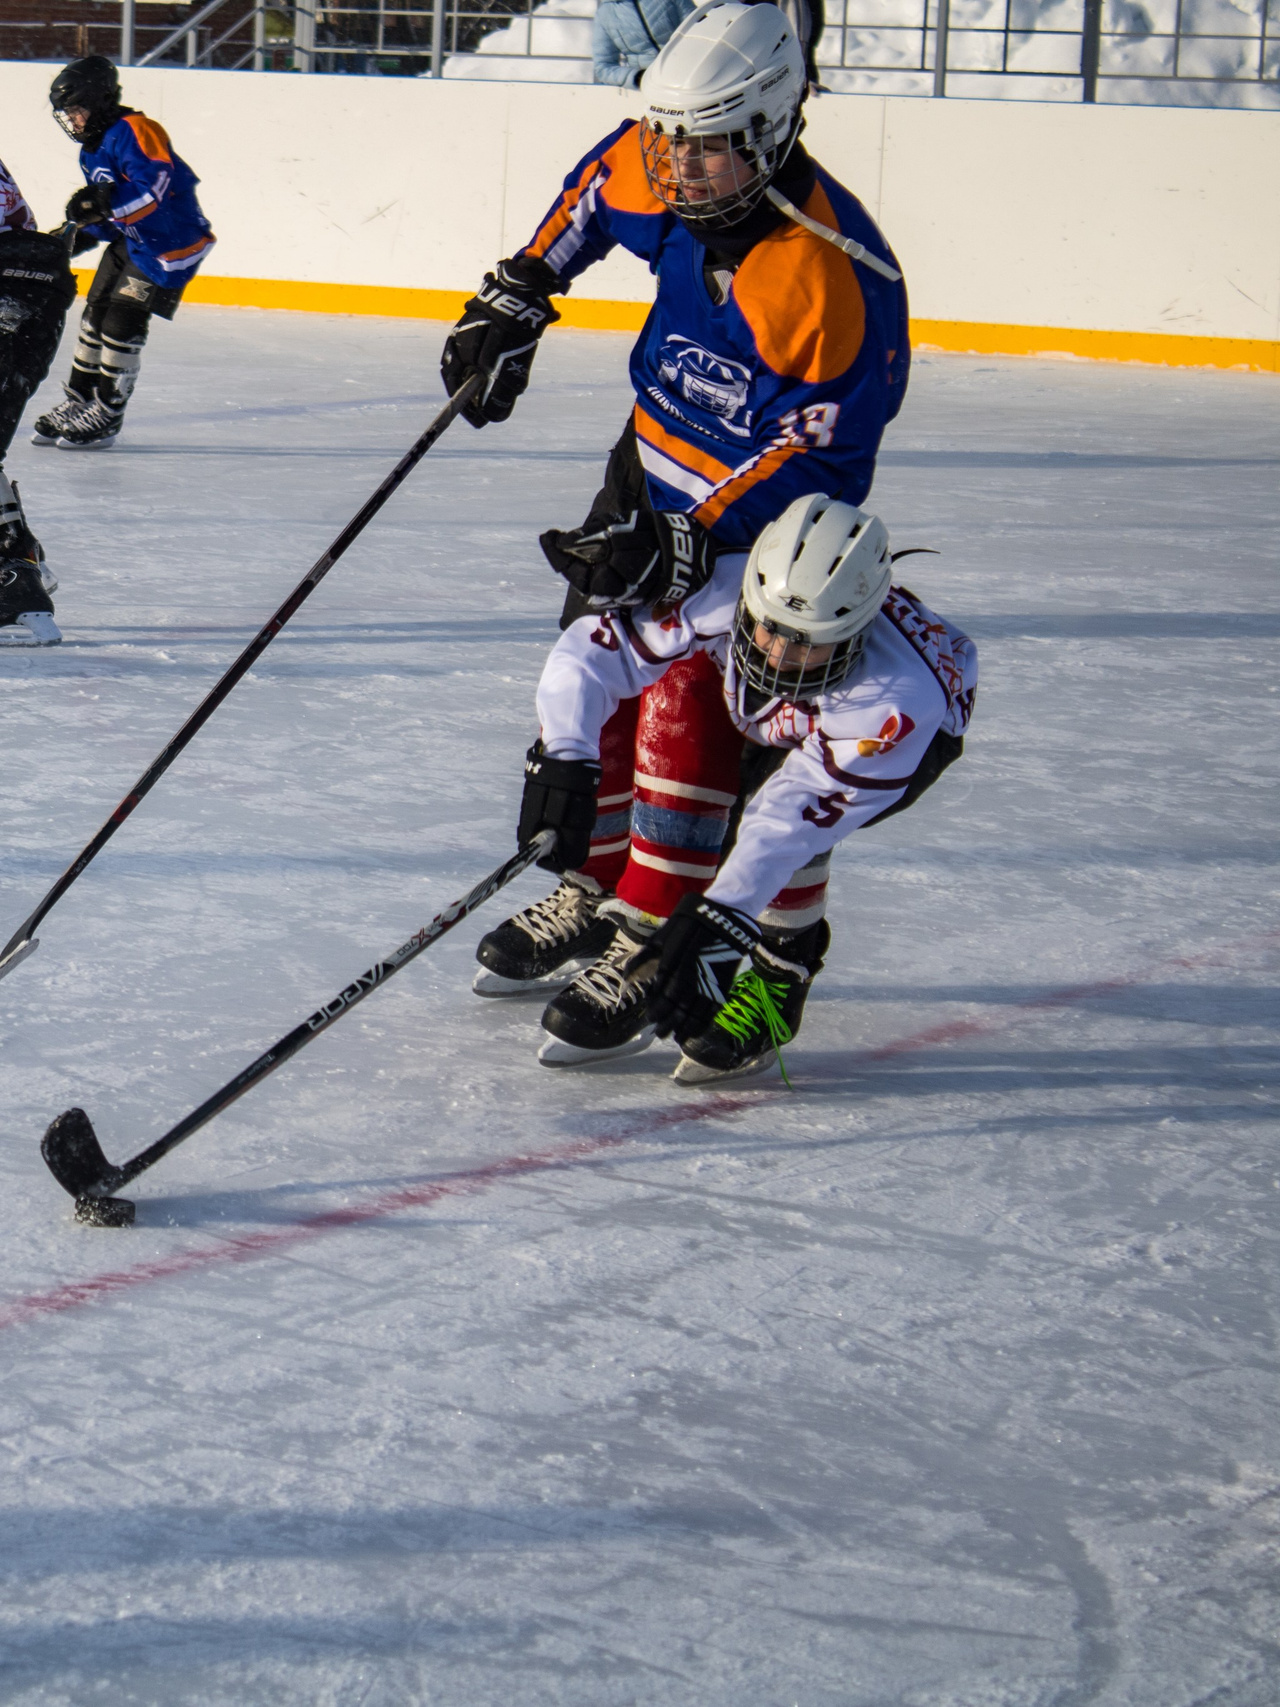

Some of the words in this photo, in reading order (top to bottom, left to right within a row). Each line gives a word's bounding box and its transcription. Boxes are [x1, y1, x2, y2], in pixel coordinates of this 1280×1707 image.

[761, 68, 791, 92] BAUER
[649, 105, 686, 117] BAUER
[2, 268, 54, 283] BAUER
[802, 791, 847, 829] 5
[307, 960, 396, 1031] VAPOR
